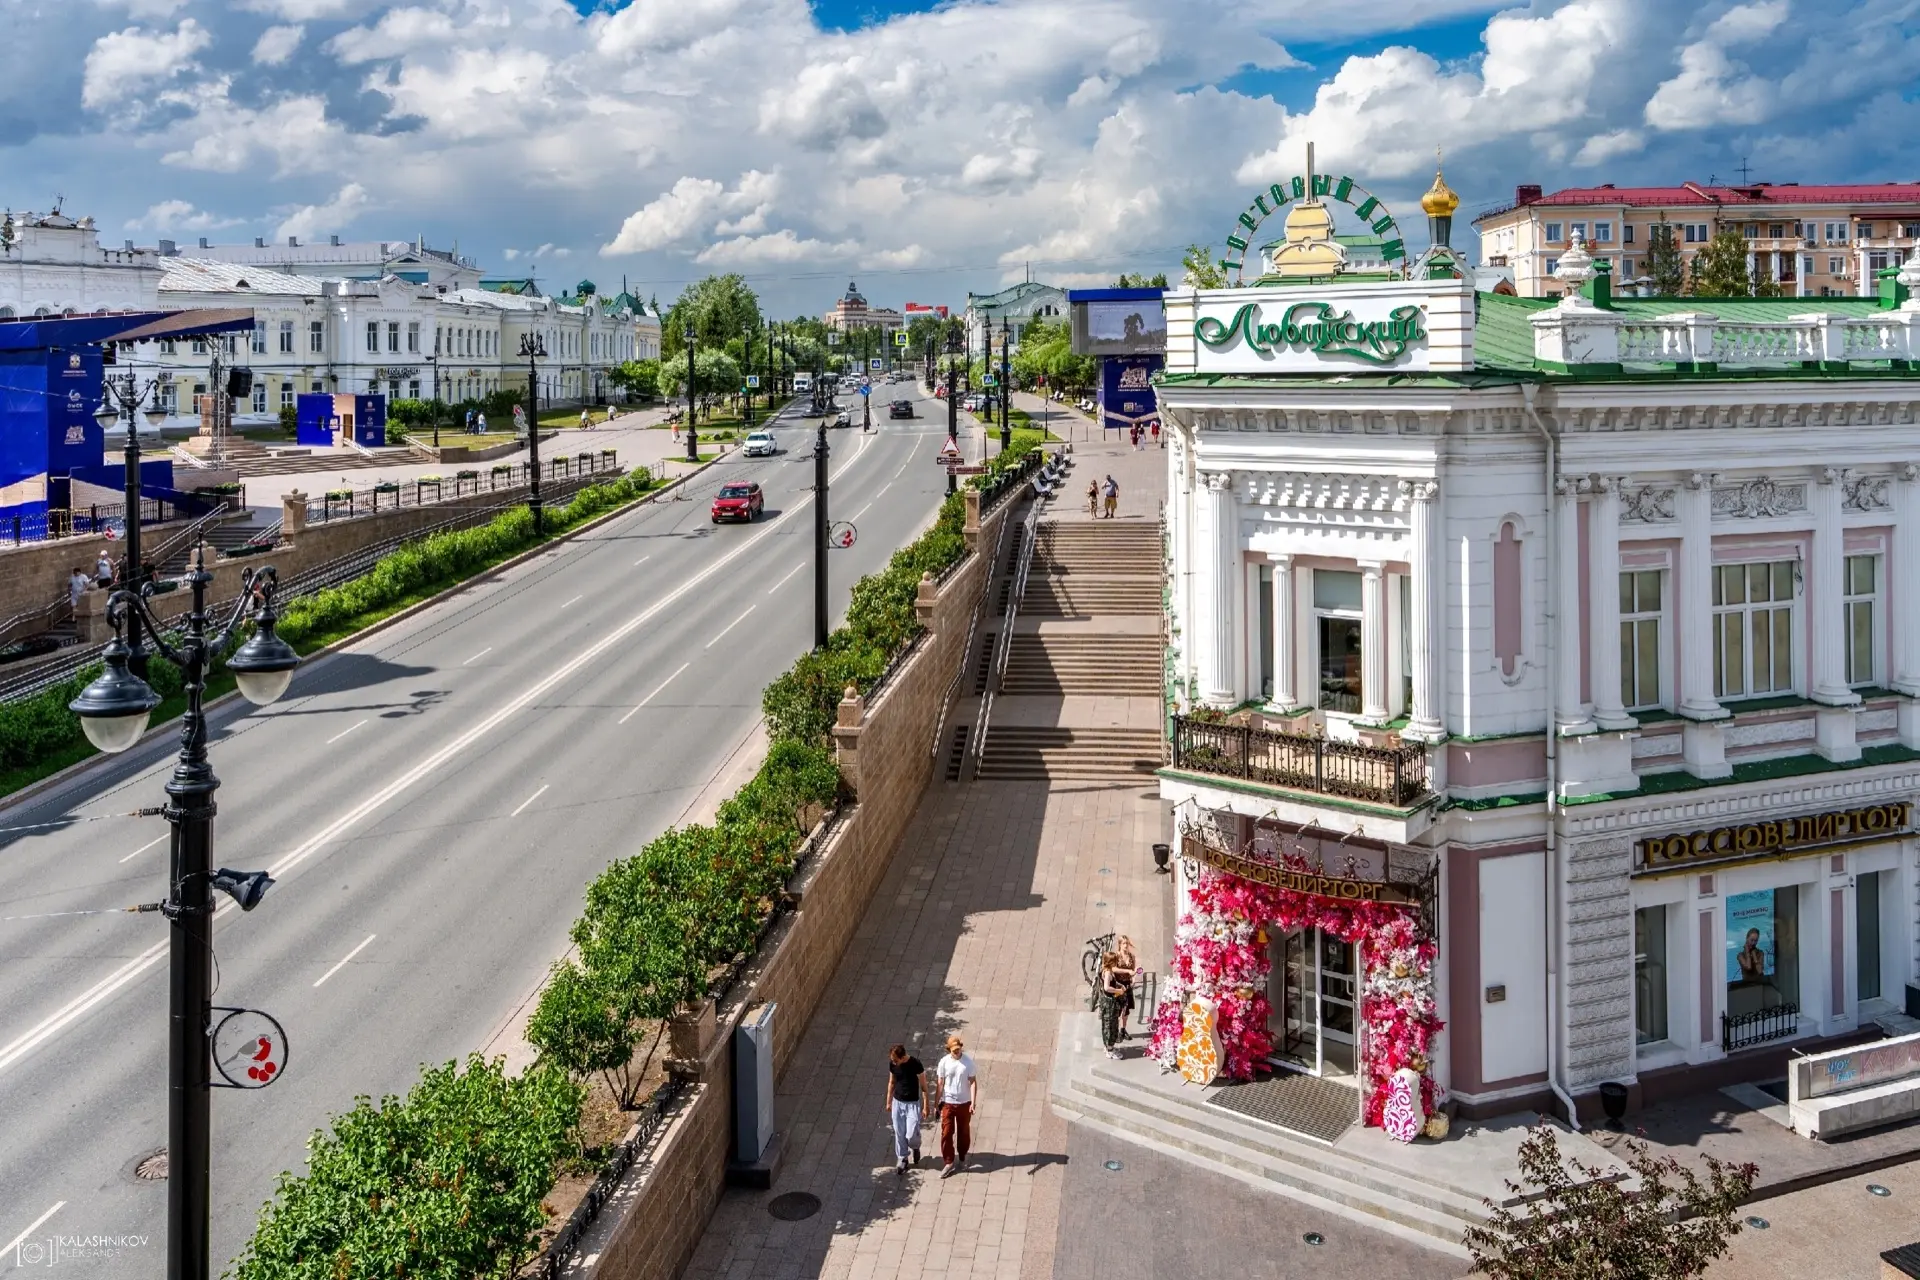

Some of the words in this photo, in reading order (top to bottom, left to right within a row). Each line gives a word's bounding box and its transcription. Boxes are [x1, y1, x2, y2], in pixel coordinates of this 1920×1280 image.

[1194, 302, 1426, 364] Любинский
[1643, 802, 1914, 865] РОССЮВЕЛИРТОРГ
[1205, 848, 1384, 900] РОССЮВЕЛИРТОРГ
